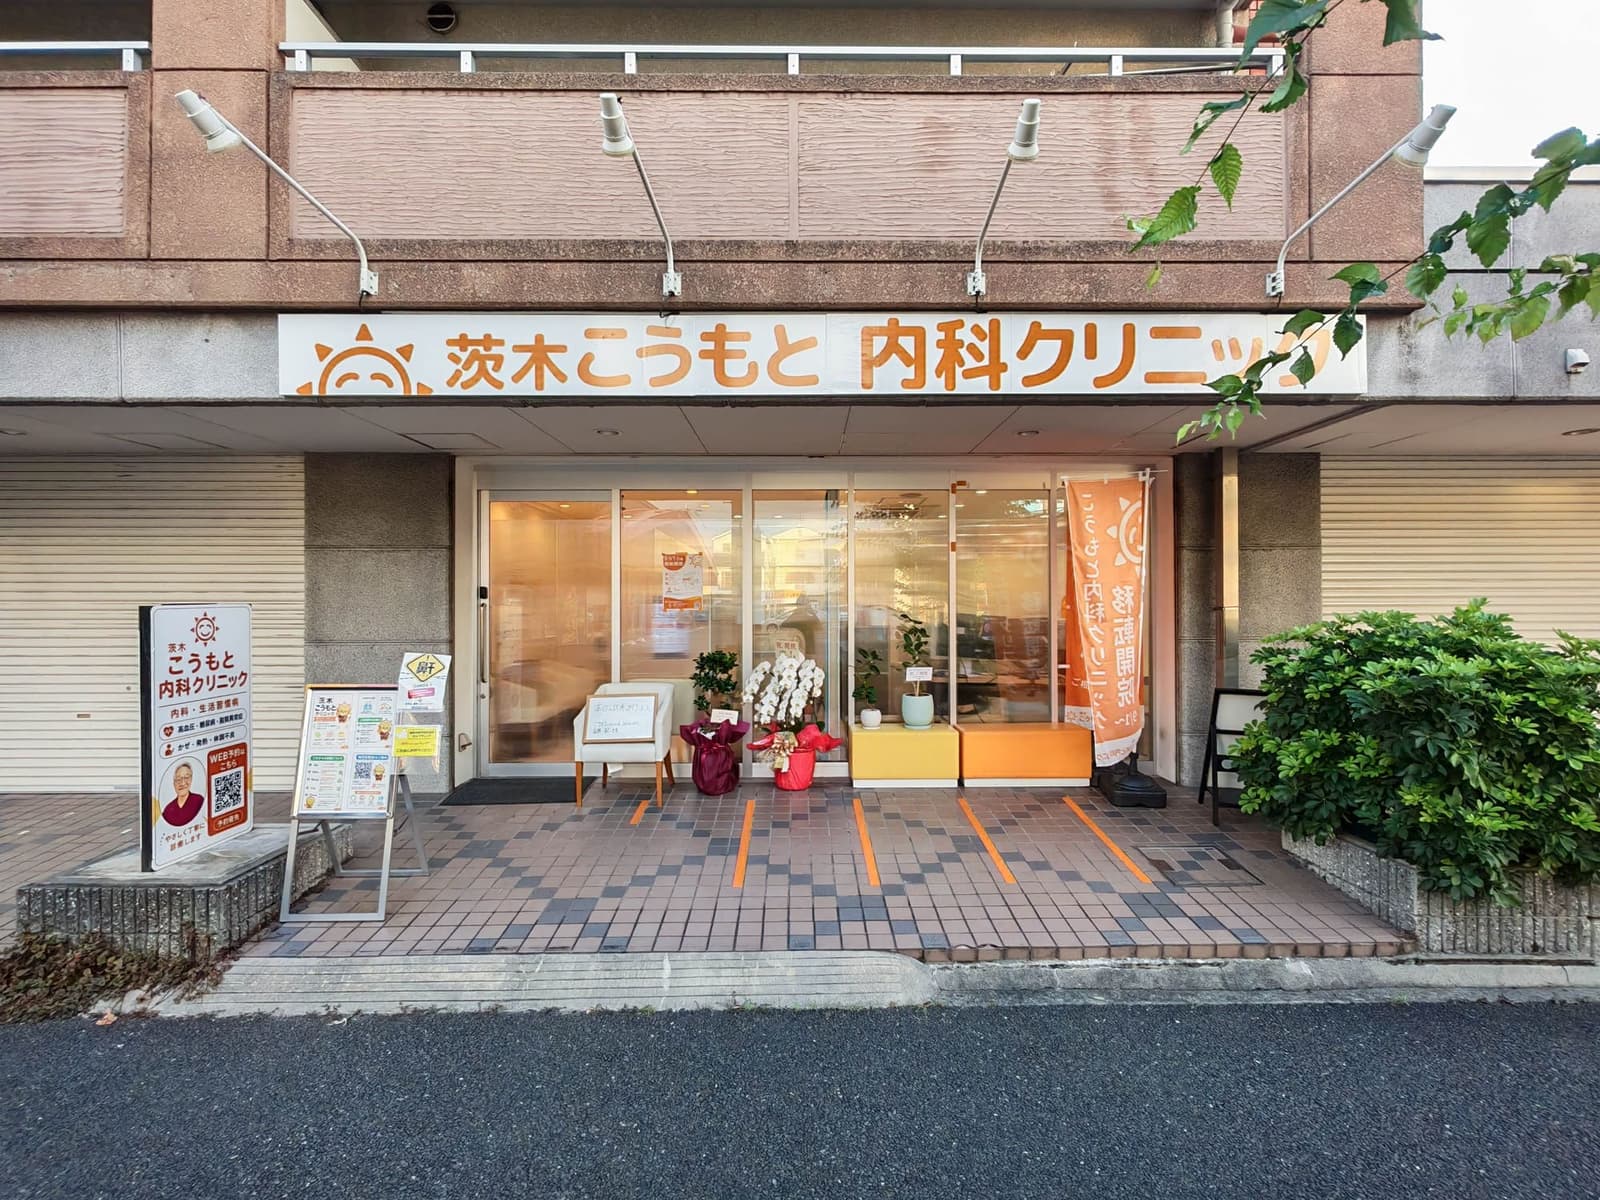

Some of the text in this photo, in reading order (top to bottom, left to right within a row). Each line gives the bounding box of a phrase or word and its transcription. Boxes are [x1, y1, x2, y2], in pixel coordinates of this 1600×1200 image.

[446, 318, 1330, 391] 茨木こうもと 内科クリニック
[168, 642, 186, 653] 茨木
[168, 650, 235, 675] こうもと
[159, 670, 248, 700] 内科クリニック
